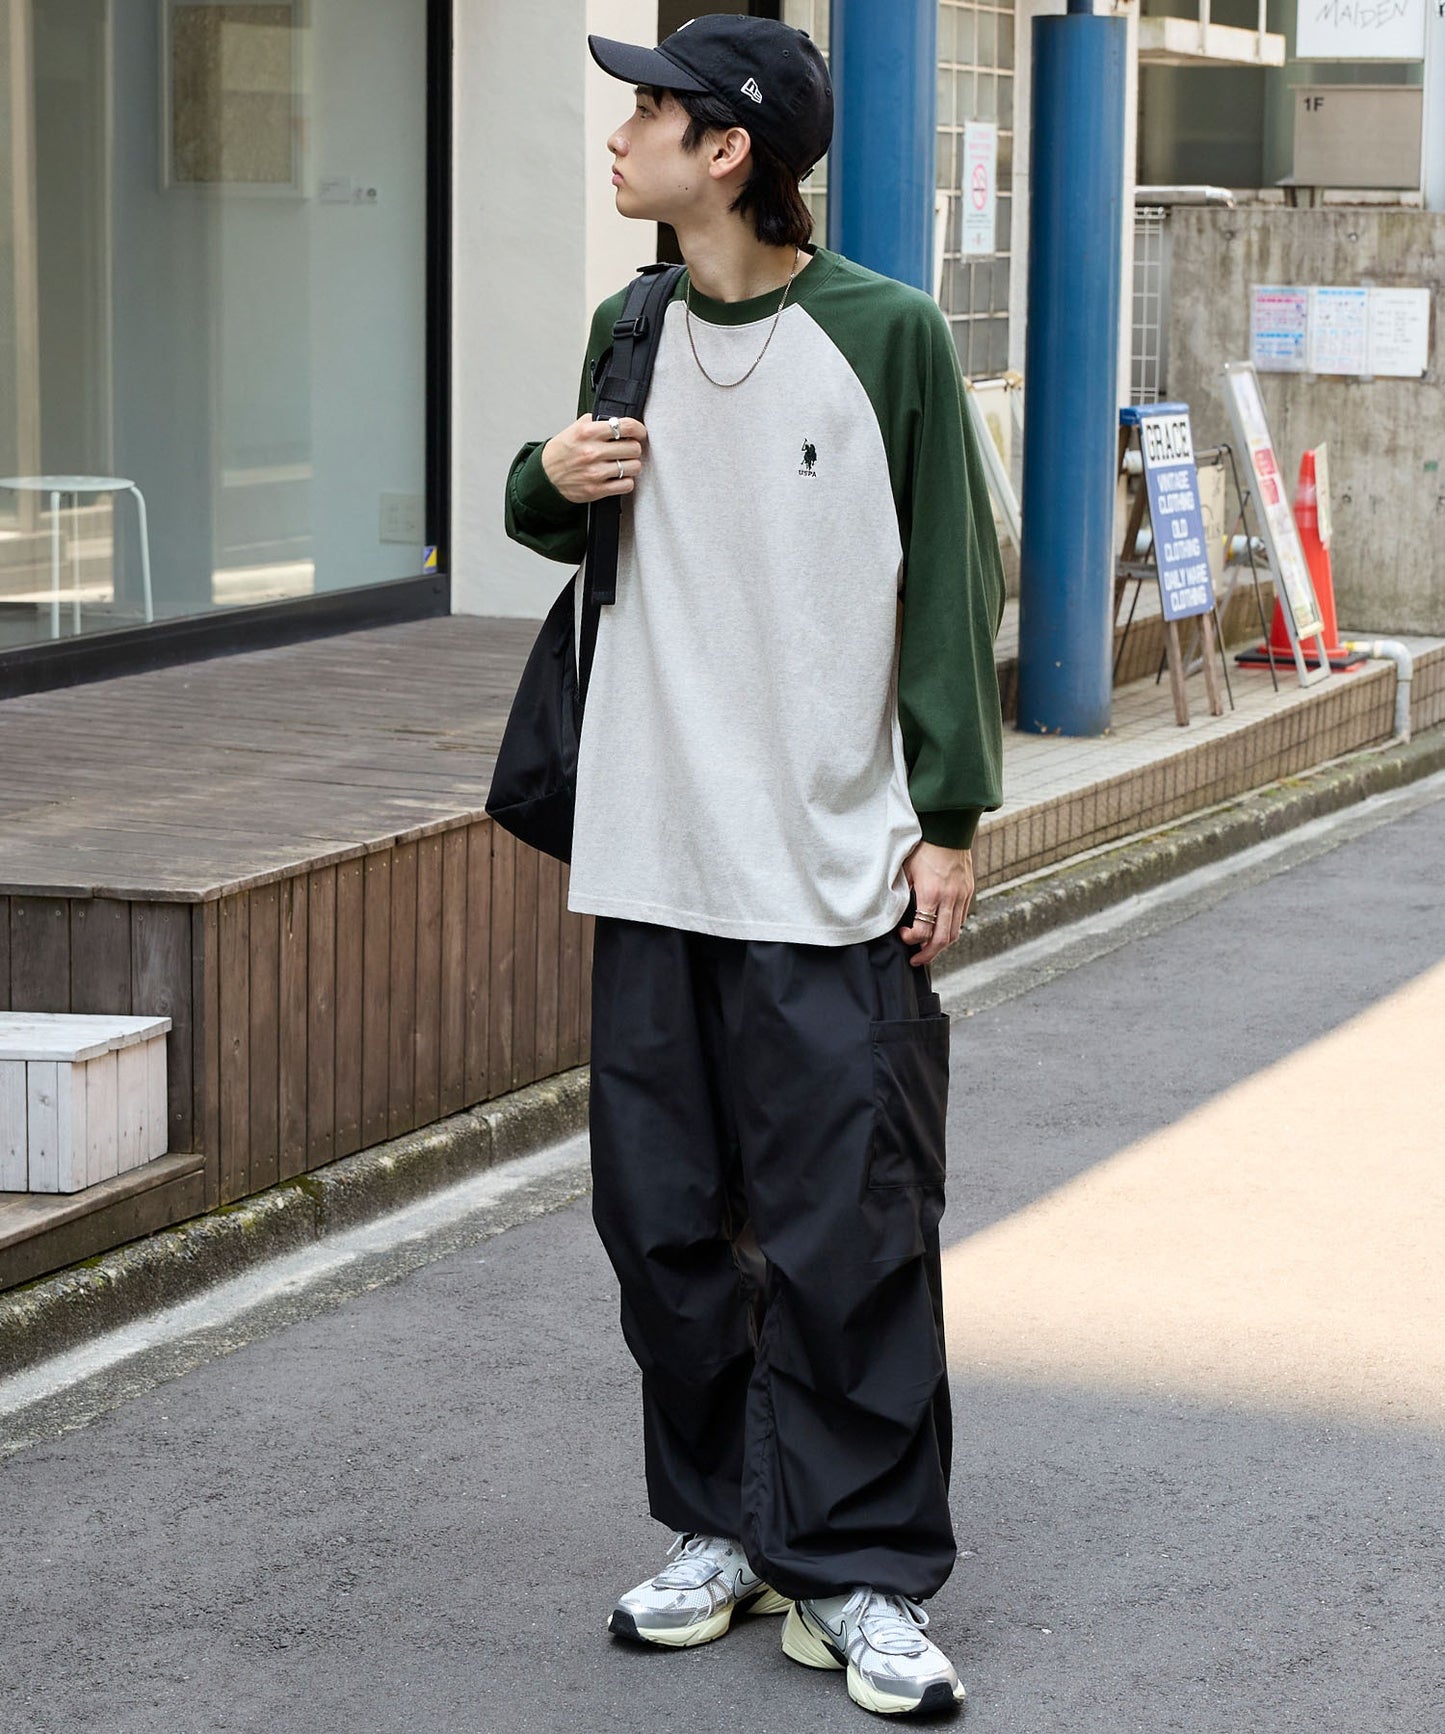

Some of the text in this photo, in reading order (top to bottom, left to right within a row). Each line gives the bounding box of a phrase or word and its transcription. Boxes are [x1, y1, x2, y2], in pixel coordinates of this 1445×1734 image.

[1303, 97, 1325, 111] 1F
[1146, 422, 1190, 461] GRACE
[798, 470, 817, 478] USPA
[1158, 491, 1195, 515] CLOTHING
[1171, 519, 1188, 538] OLD
[1164, 538, 1200, 562] CLOTHING
[1170, 586, 1207, 612] CLOTHING
